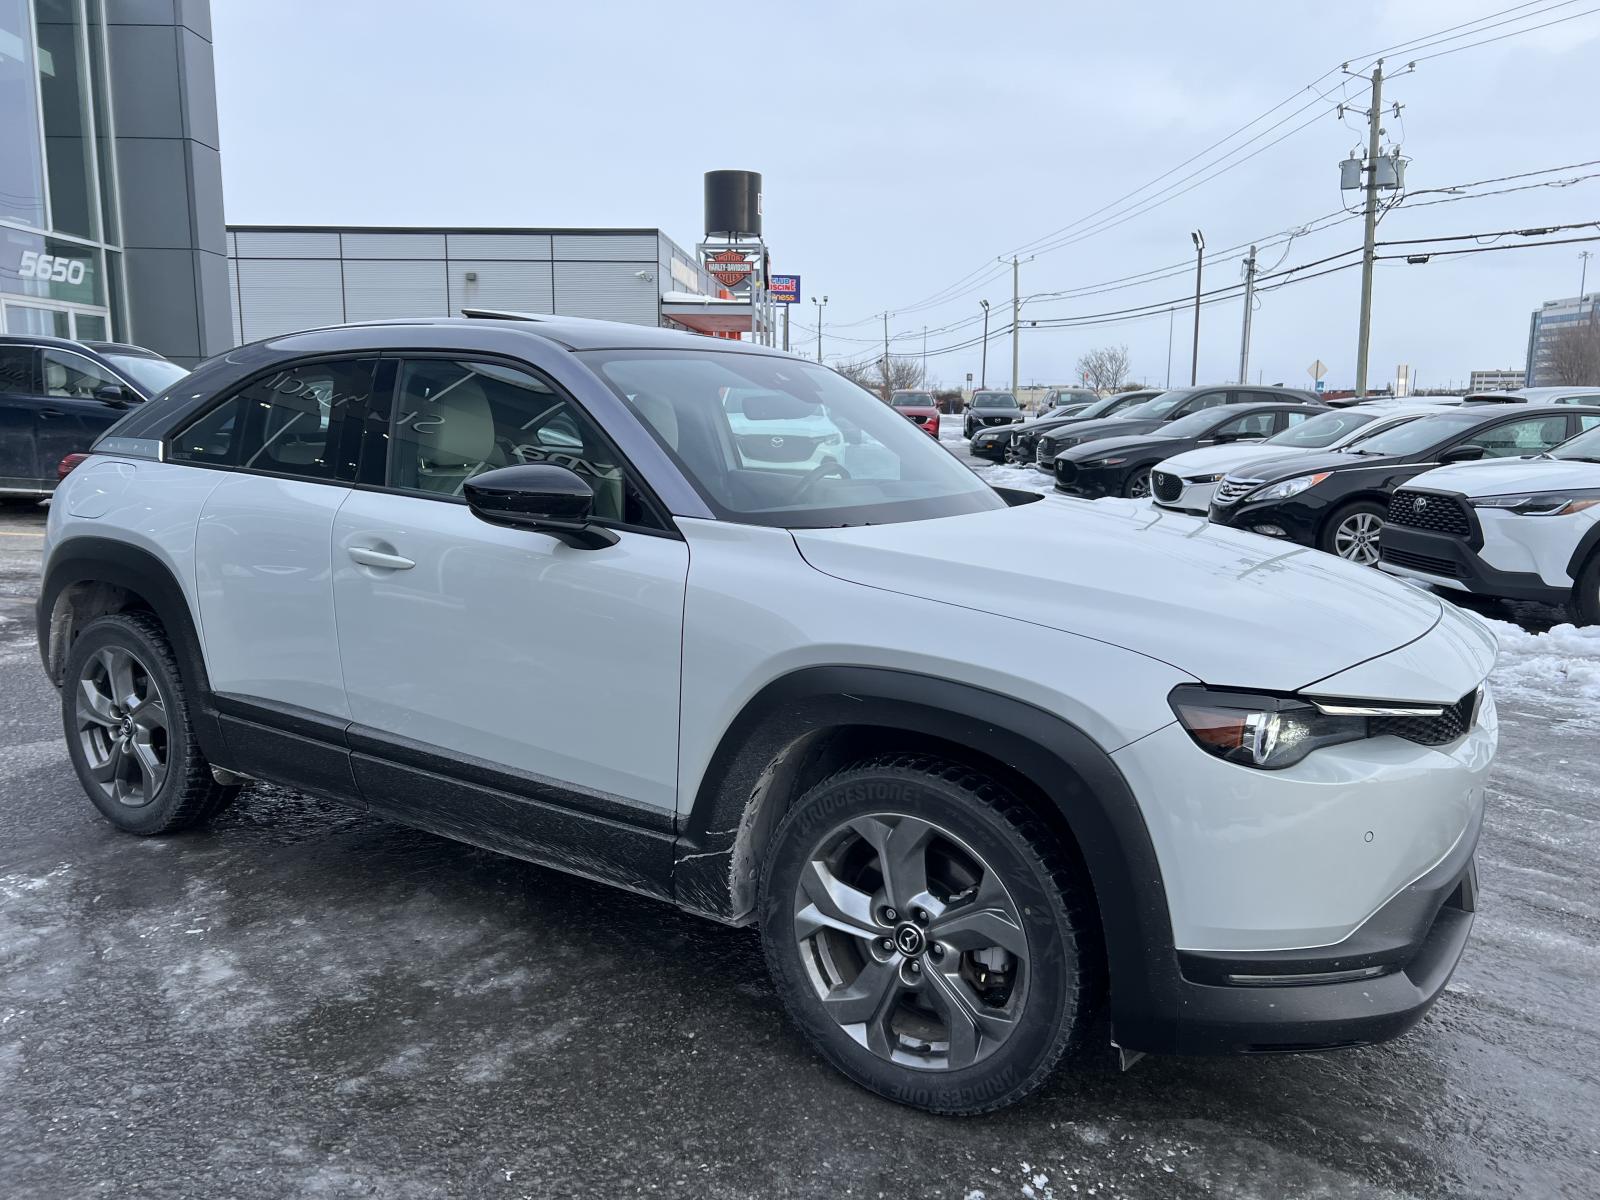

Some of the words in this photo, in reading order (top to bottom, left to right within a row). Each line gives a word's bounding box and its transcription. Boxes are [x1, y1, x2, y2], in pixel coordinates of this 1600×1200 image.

[19, 250, 85, 285] 5650
[709, 263, 750, 272] HARLEY-DAVIDSON
[717, 253, 742, 262] MOTOR
[796, 783, 914, 832] BRIDGESTONE
[891, 1063, 1018, 1103] BRIDGESTONE
